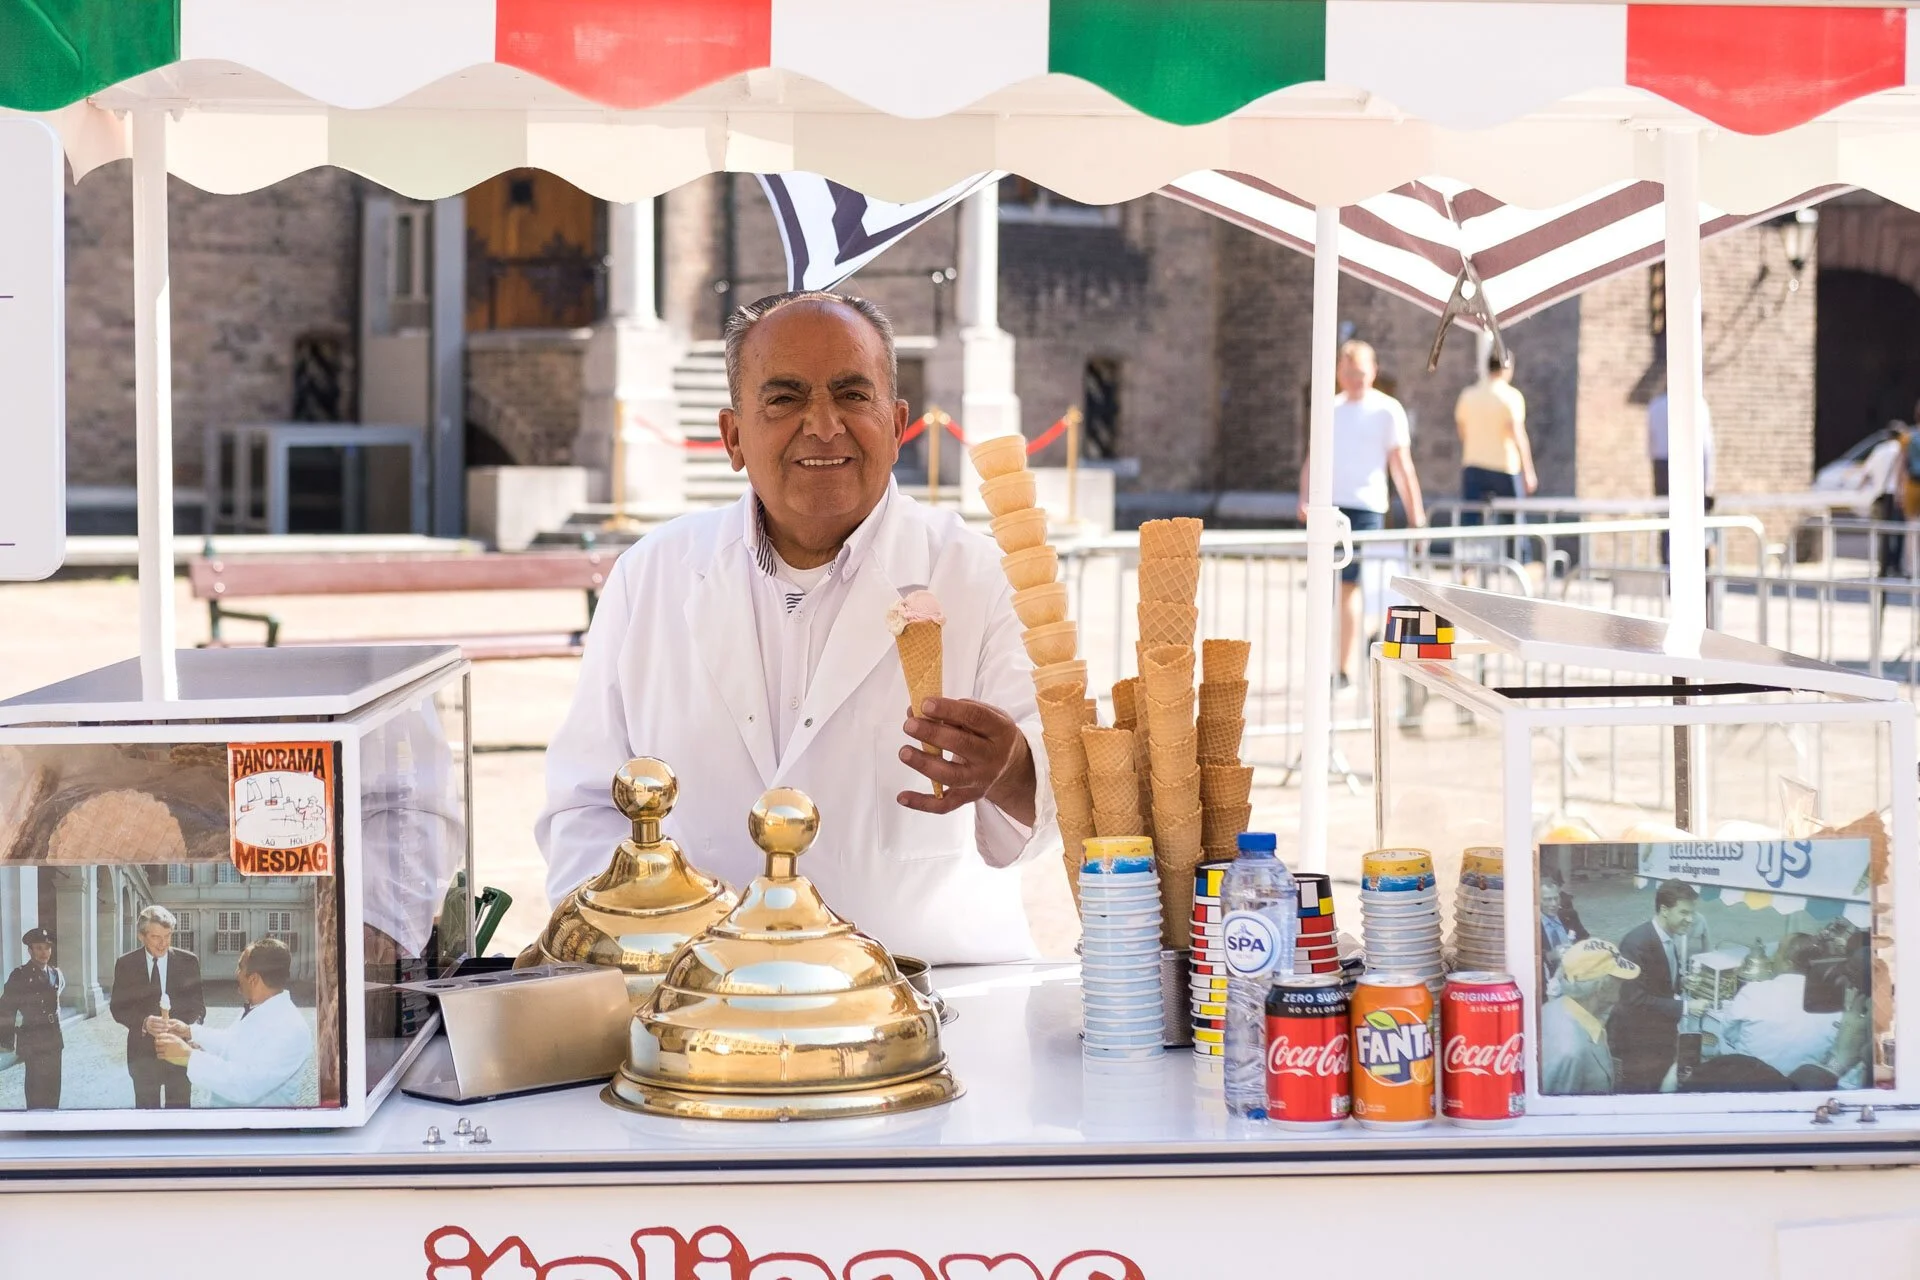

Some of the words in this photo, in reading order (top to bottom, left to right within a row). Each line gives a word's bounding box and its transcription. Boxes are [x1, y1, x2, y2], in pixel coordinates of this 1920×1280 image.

[231, 747, 326, 780] PANORAMA
[235, 842, 328, 872] MESDAG
[1227, 935, 1266, 952] SPA
[1281, 992, 1314, 1003] ZERO
[1316, 990, 1348, 1003] SUGA
[1450, 991, 1506, 1002] ORIGINAL
[1288, 1006, 1302, 1014] NO
[1268, 1033, 1350, 1077] Coca-Col
[1355, 1023, 1434, 1065] FANTA
